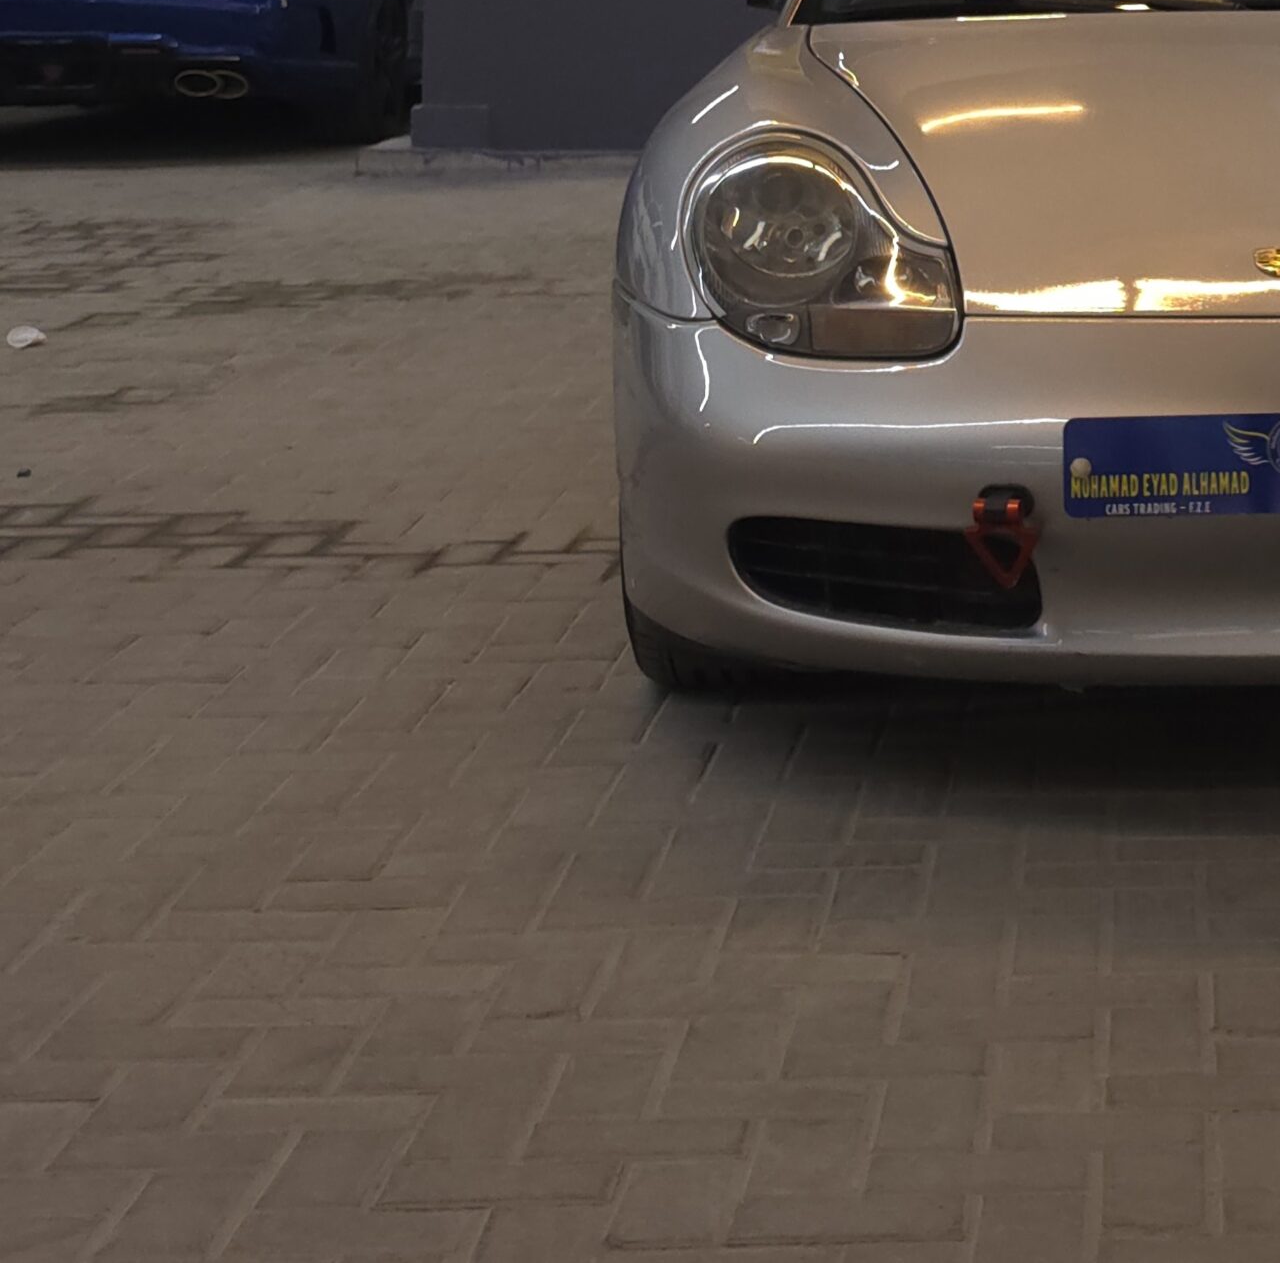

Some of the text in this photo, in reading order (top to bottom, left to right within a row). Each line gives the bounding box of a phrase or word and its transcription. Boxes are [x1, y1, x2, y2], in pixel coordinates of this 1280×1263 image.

[1071, 471, 1250, 499] MOHAMAD EYAD ALHAMAD
[1105, 503, 1130, 515] CARS
[1133, 502, 1177, 515] TRADING
